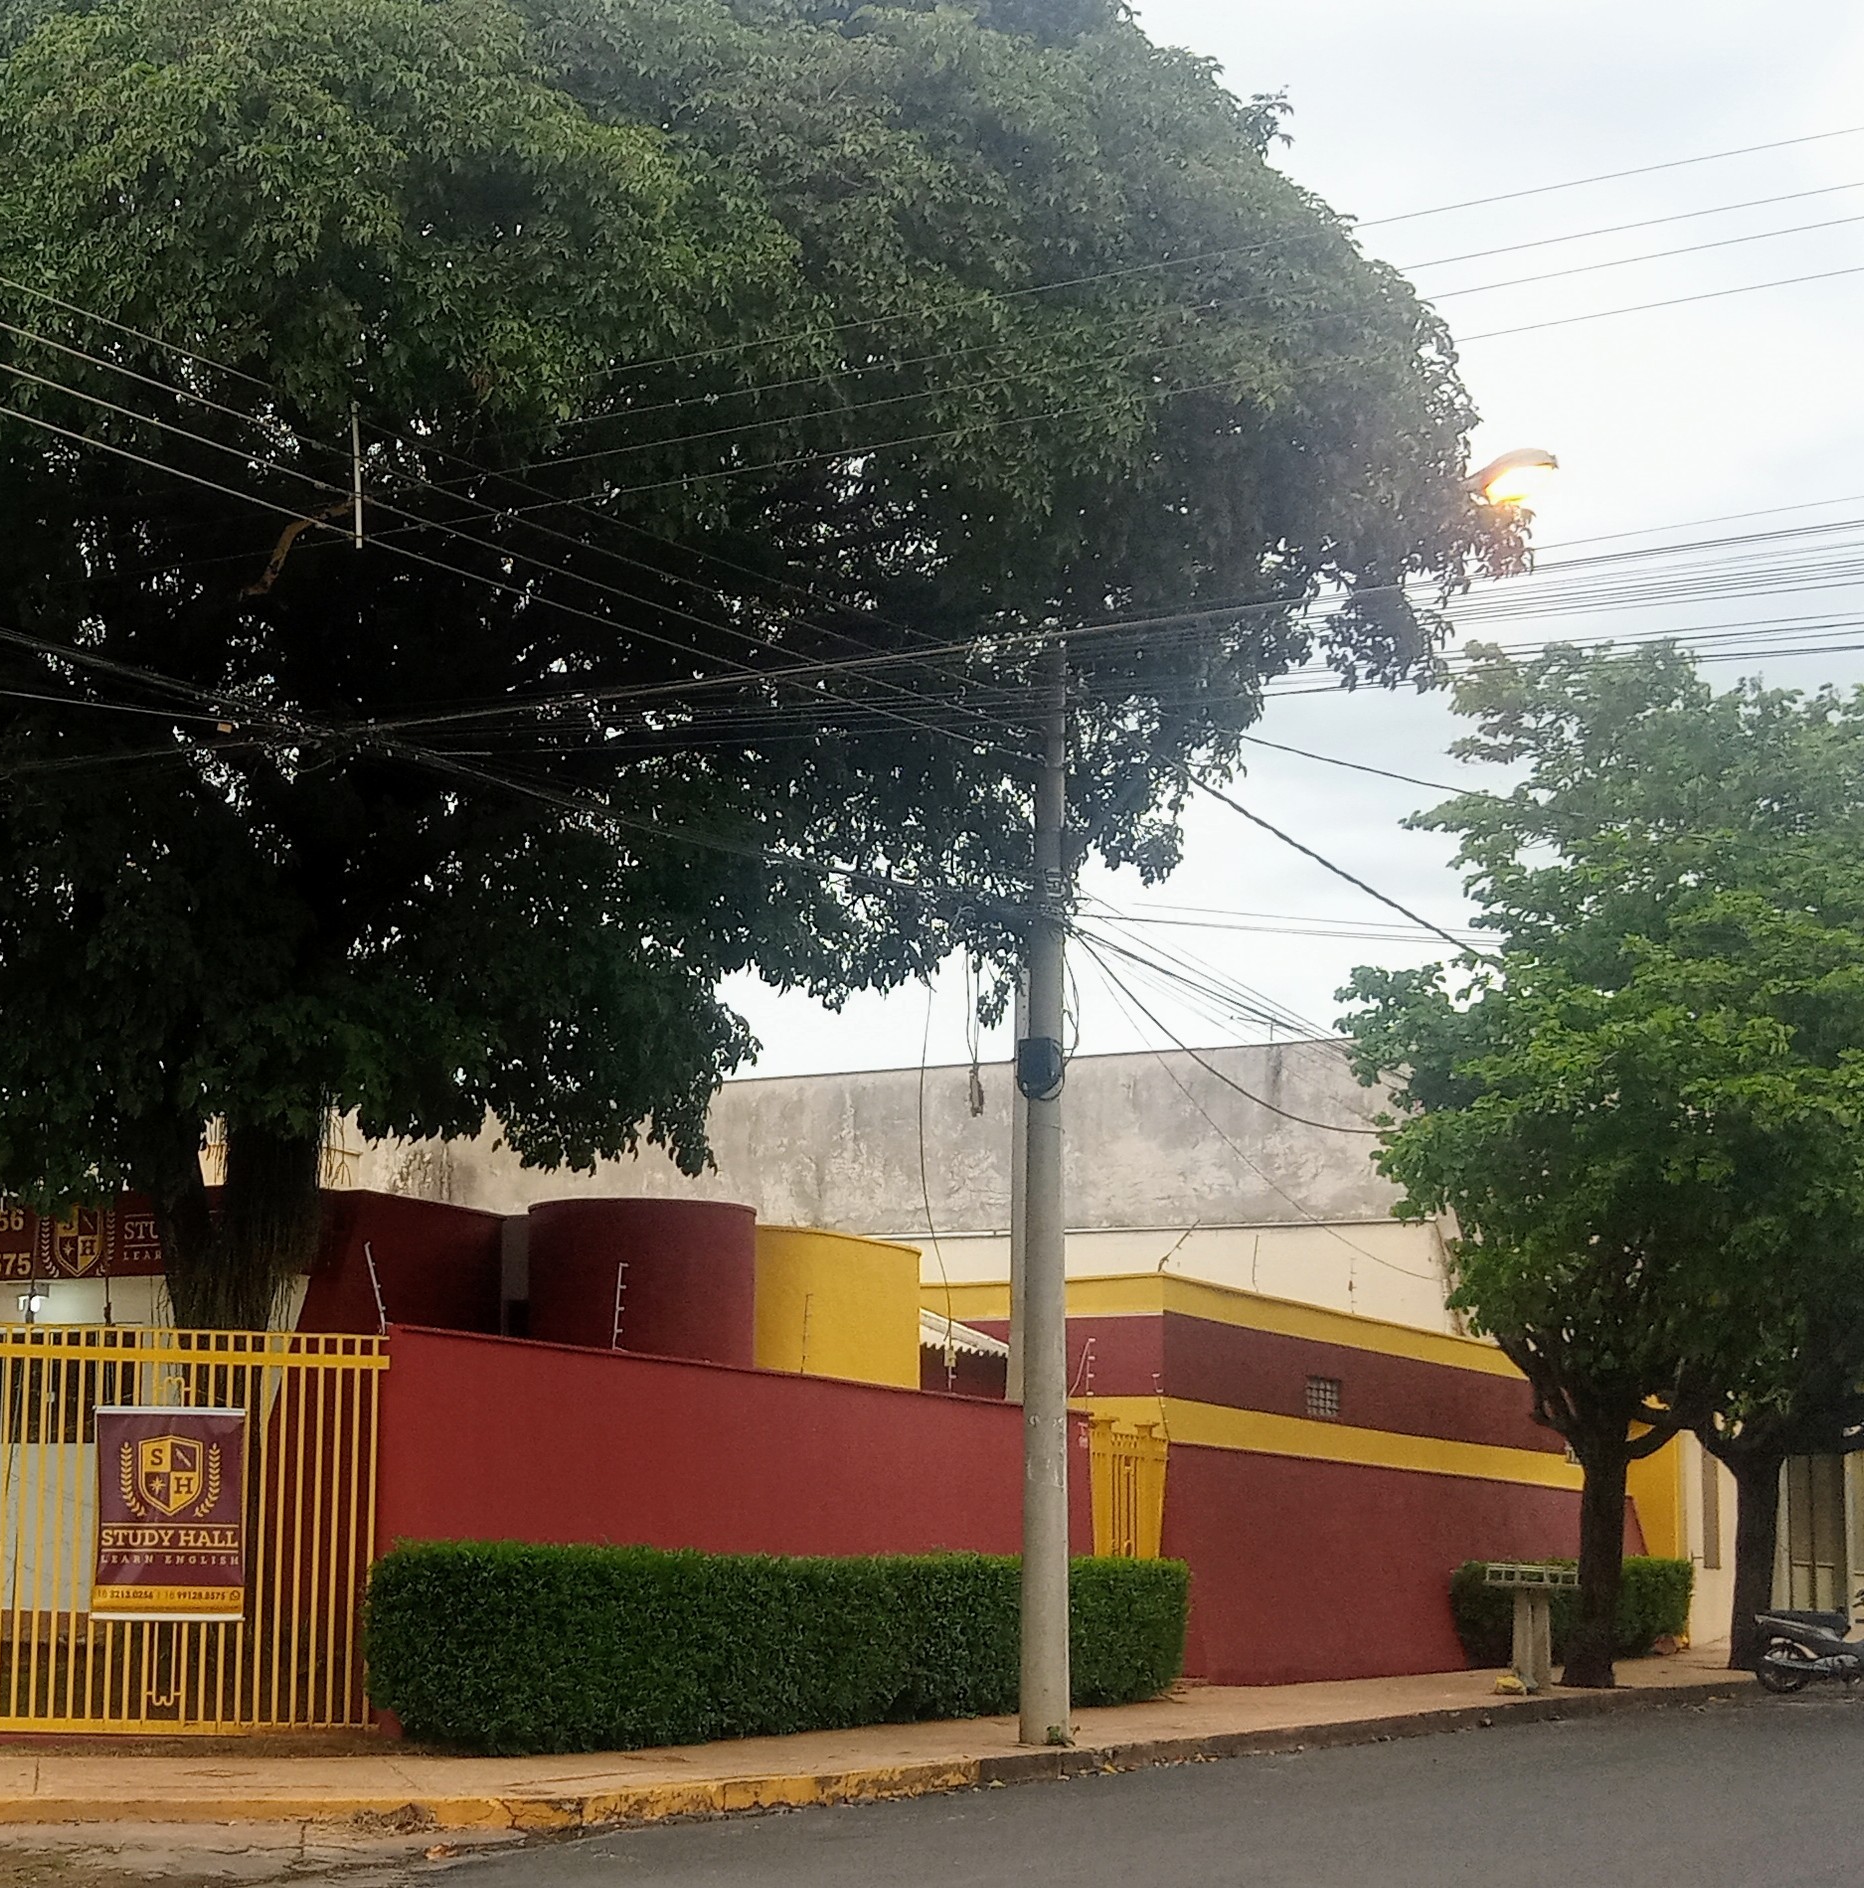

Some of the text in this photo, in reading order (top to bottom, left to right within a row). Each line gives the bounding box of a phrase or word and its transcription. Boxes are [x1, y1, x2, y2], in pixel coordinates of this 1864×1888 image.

[80, 1240, 96, 1256] H
[123, 1250, 162, 1260] LEAR
[151, 1448, 163, 1466] S
[174, 1476, 194, 1495] H
[101, 1529, 239, 1548] STUDY HALL
[101, 1554, 239, 1565] LEARN ENGLISH
